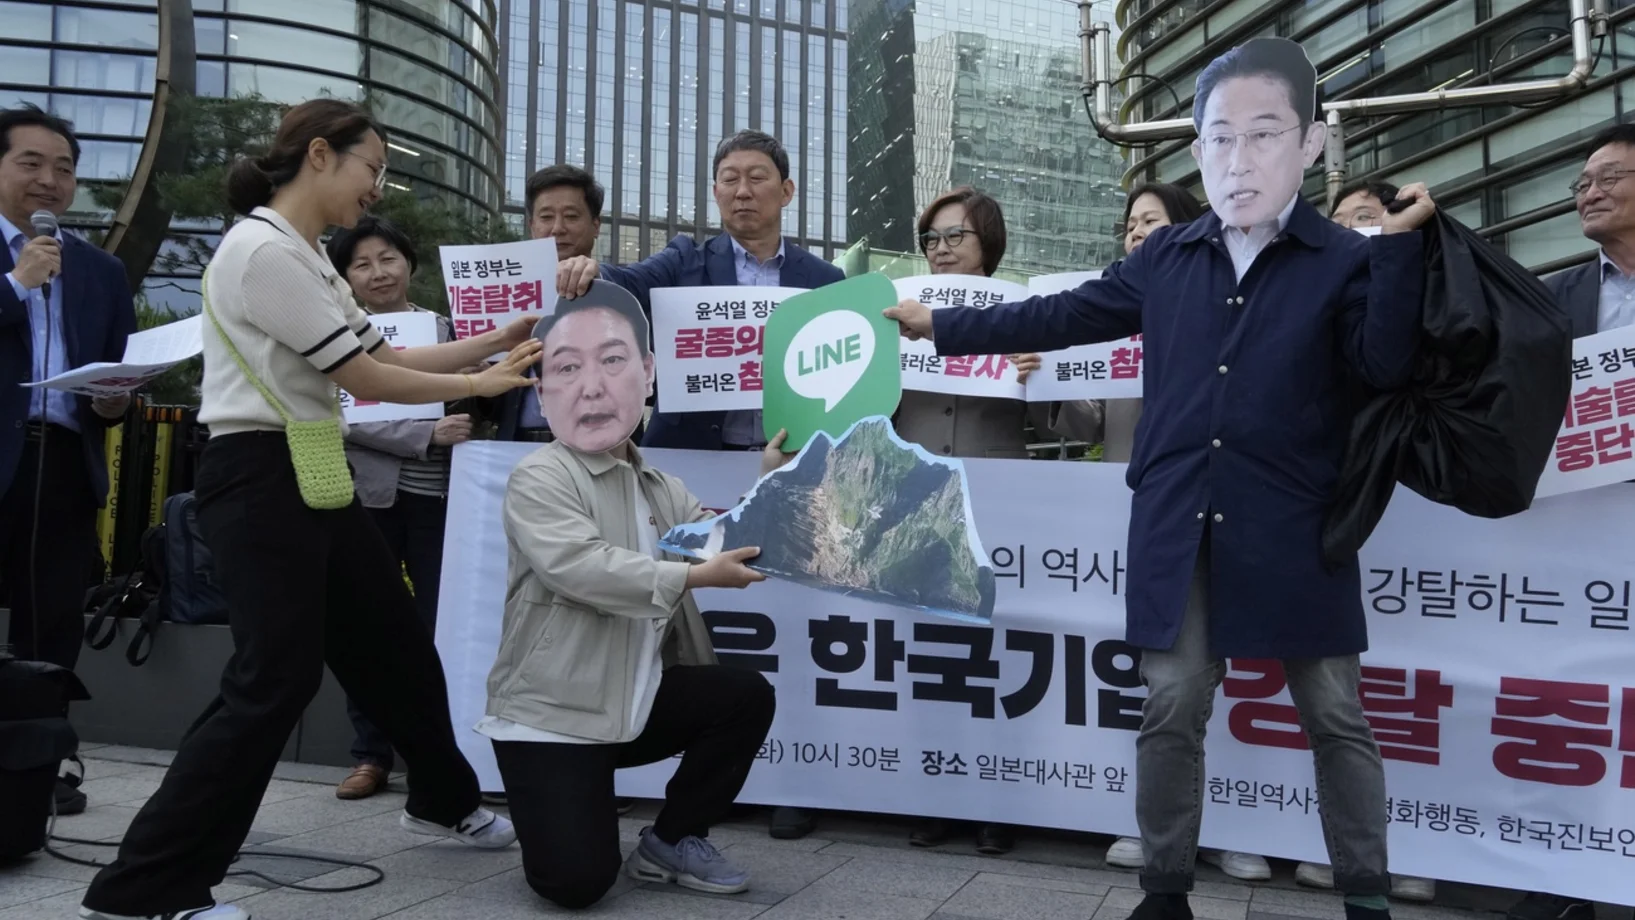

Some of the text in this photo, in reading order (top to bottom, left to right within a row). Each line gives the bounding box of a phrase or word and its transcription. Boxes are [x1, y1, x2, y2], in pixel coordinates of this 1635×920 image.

[450, 258, 523, 279] 일본 정부는
[448, 280, 543, 315] 기술탈취
[695, 300, 747, 321] 윤석열
[918, 287, 967, 307] 윤석열
[797, 333, 861, 377] LINE
[1055, 361, 1108, 382] 불러온
[684, 372, 737, 394] 불러온
[1555, 422, 1635, 473] 중단
[1042, 547, 1126, 596] 역사
[1366, 566, 1566, 627] 강탈하는
[792, 742, 840, 768] 10시
[847, 746, 901, 773] 30분
[921, 750, 969, 777] 장소
[975, 753, 1096, 790] 일본대사관
[1103, 765, 1129, 794] 앞
[1208, 776, 1319, 816] 한일역사
